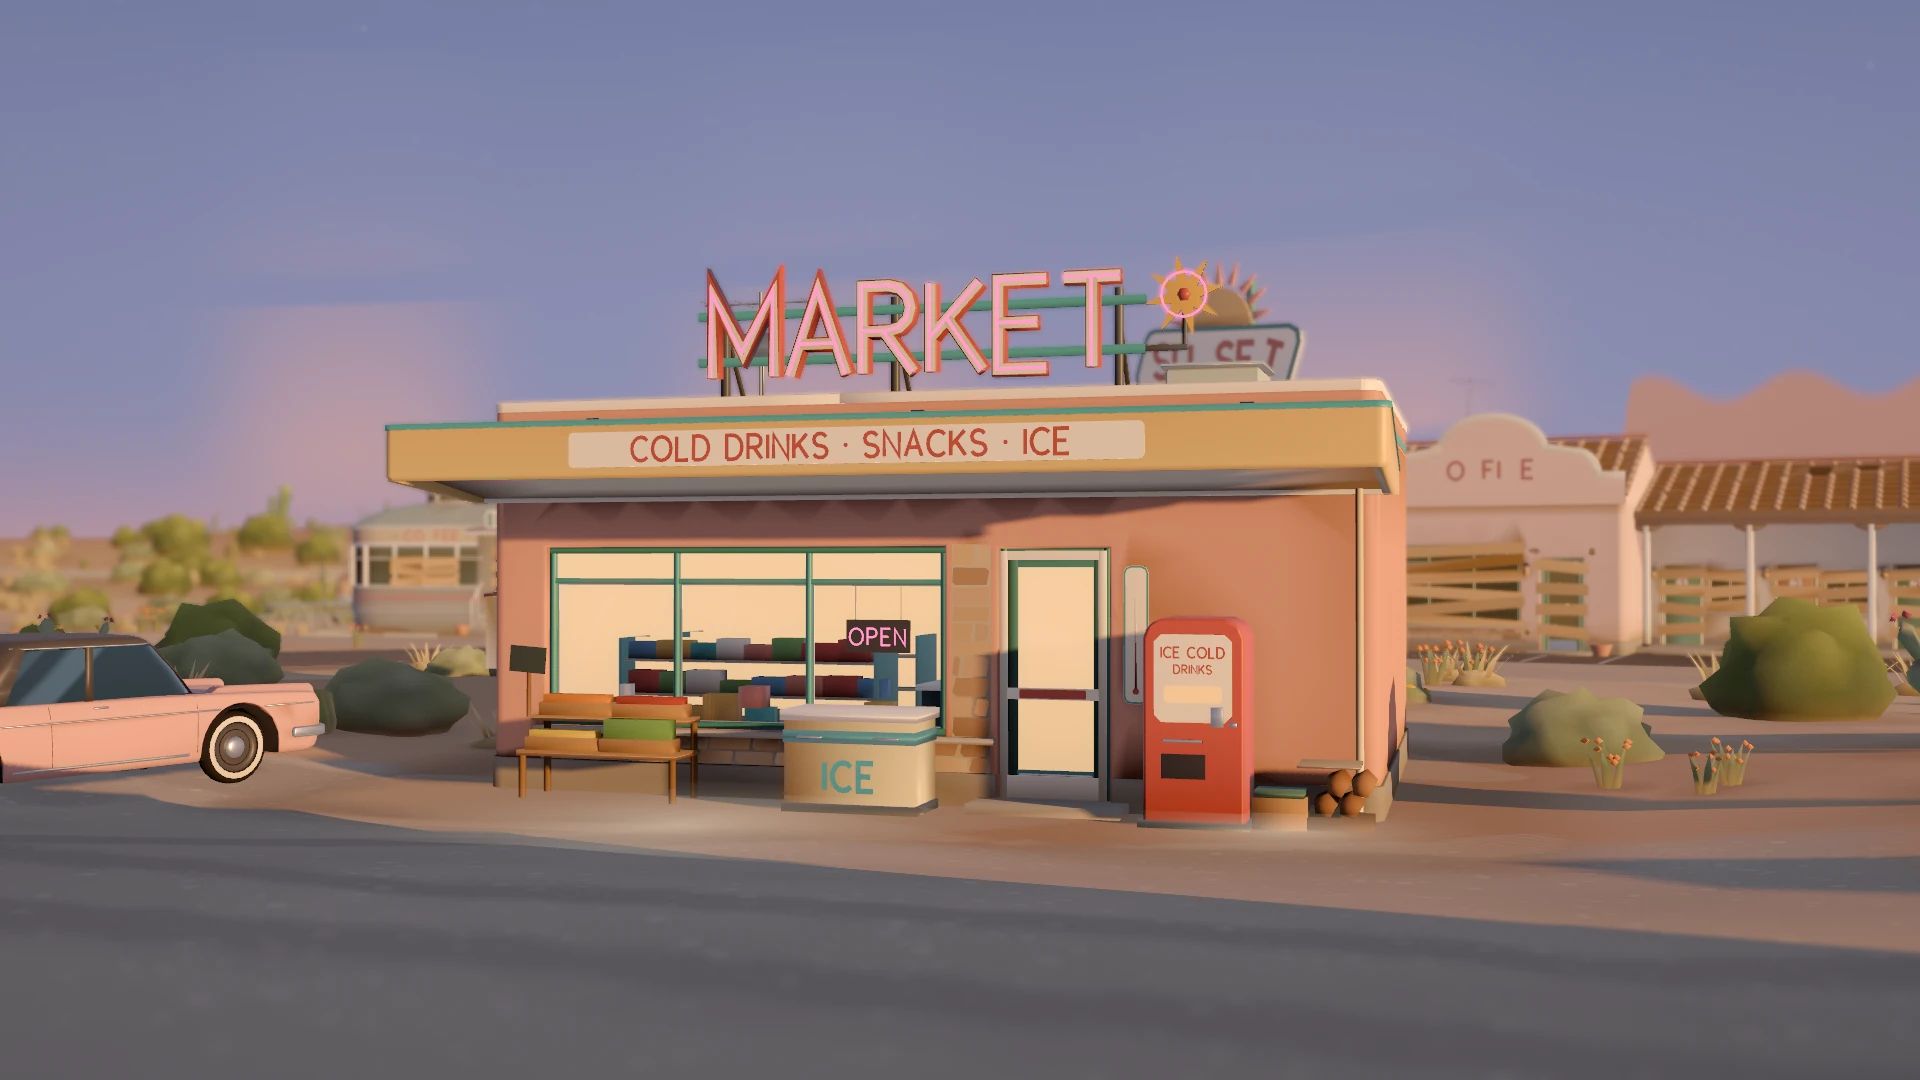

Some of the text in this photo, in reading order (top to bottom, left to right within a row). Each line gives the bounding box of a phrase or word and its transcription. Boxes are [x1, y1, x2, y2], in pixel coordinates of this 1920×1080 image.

[706, 264, 1123, 380] MARKET
[630, 425, 1070, 463] COLD DRINKS SNACKS ICE
[1446, 458, 1535, 482] OFIE
[402, 529, 458, 542] COFEE
[848, 626, 908, 649] OPEN
[1160, 646, 1226, 660] ICE COLD
[1172, 664, 1213, 676] DRINKS
[821, 759, 875, 795] ICE
